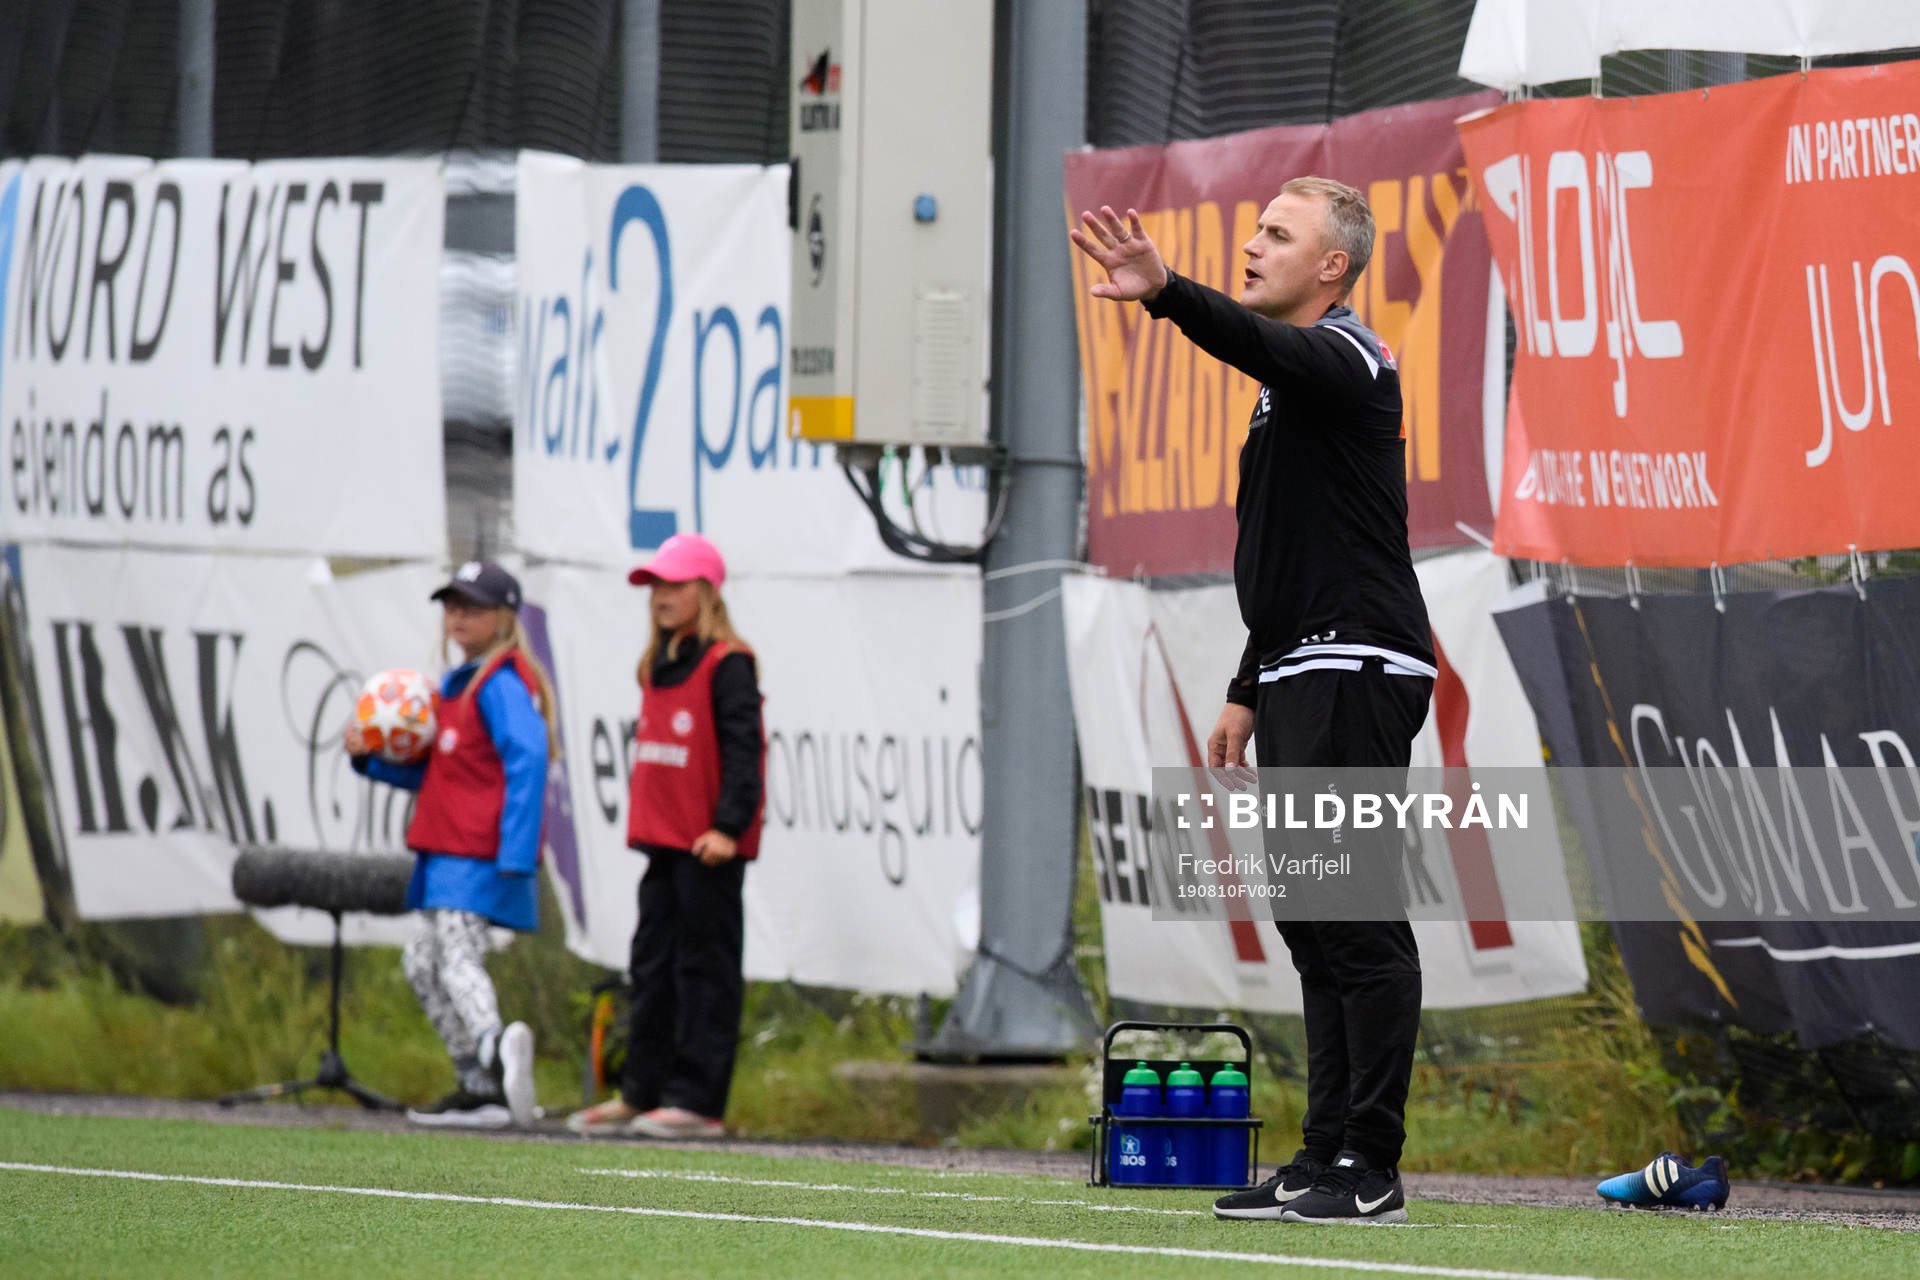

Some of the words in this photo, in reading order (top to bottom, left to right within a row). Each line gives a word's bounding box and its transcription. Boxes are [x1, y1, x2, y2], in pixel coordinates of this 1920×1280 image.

[1785, 122, 1812, 184] IN
[14, 180, 186, 364] NORD
[212, 180, 385, 372] WEST
[10, 388, 186, 524] eiendom
[206, 426, 257, 527] as
